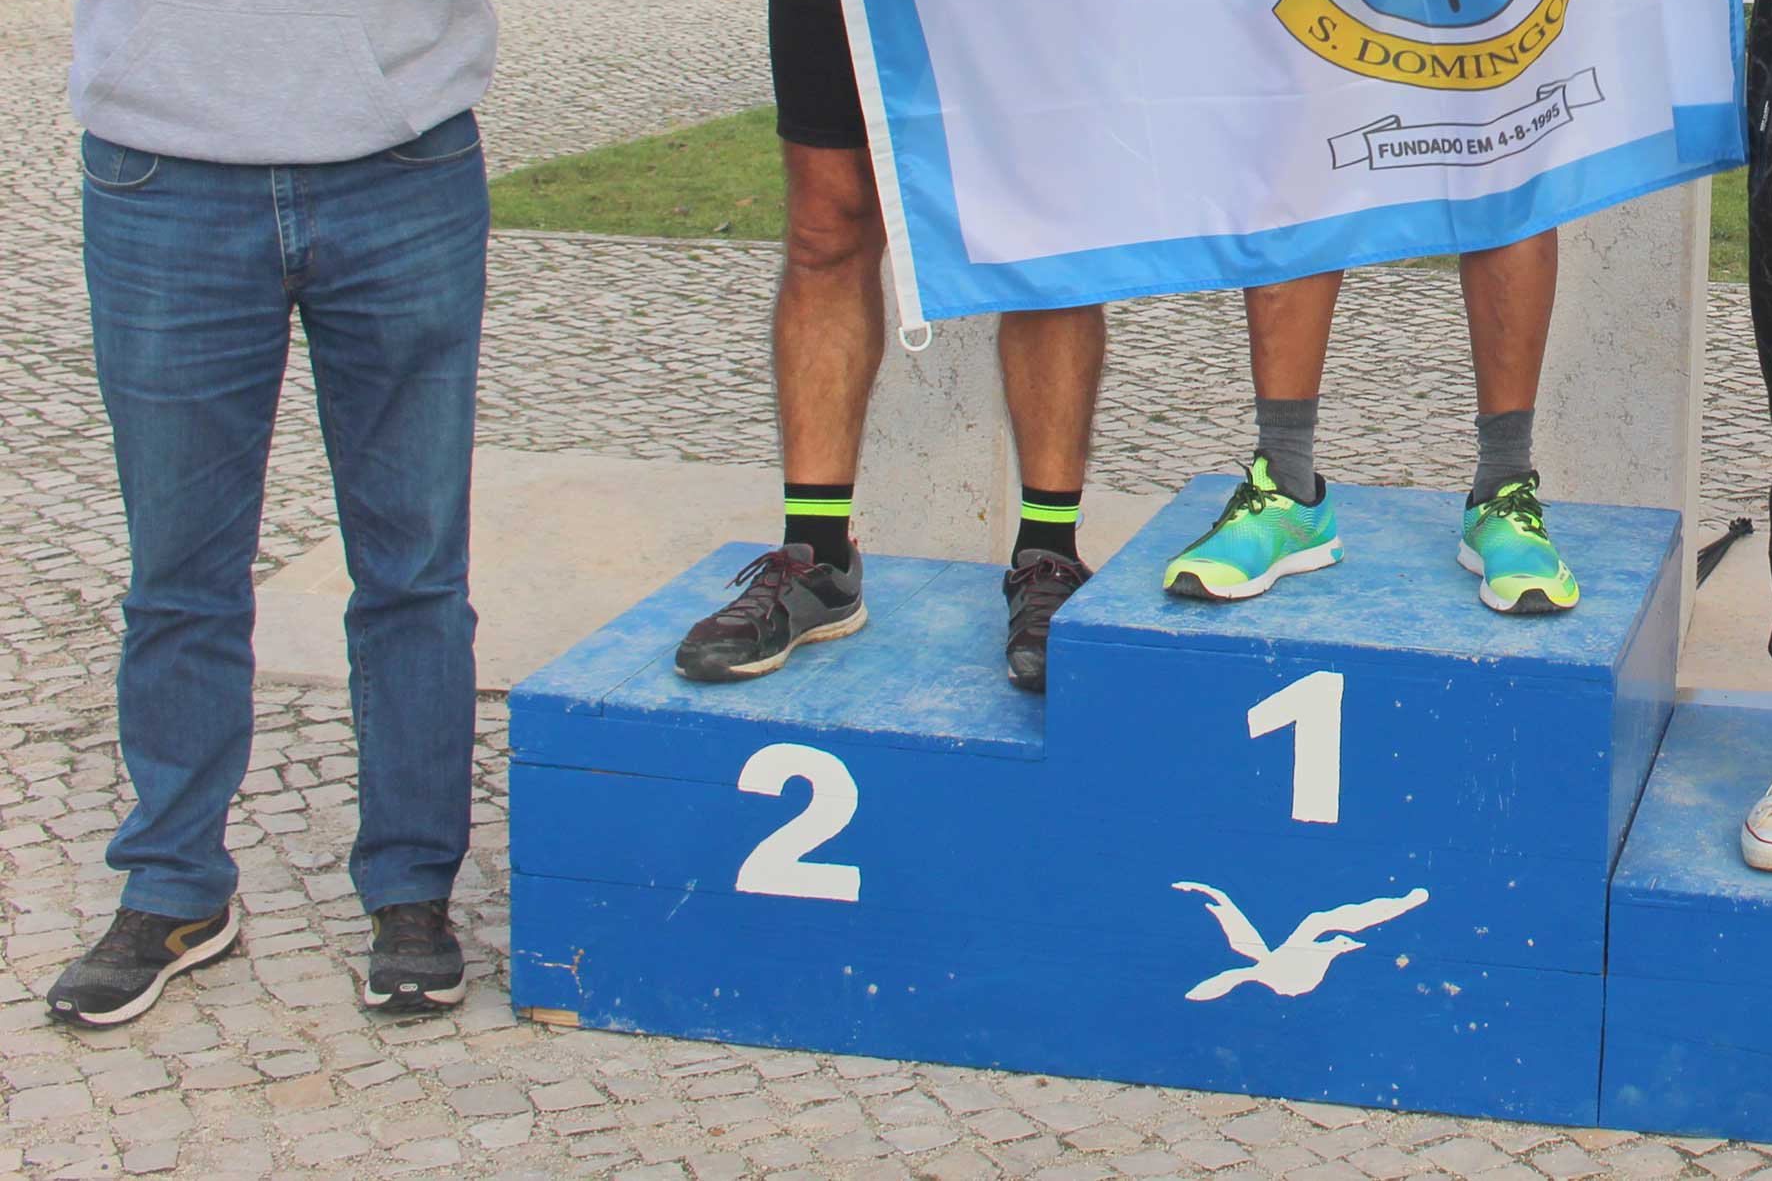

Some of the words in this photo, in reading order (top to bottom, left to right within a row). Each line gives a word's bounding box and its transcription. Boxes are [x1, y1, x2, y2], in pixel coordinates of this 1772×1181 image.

[1307, 14, 1339, 51] S.
[1378, 137, 1463, 159] FUNDADO
[1466, 139, 1494, 155] EM
[1497, 103, 1561, 148] 4-8-1995
[1246, 670, 1345, 824] 1
[735, 742, 862, 903] 2
